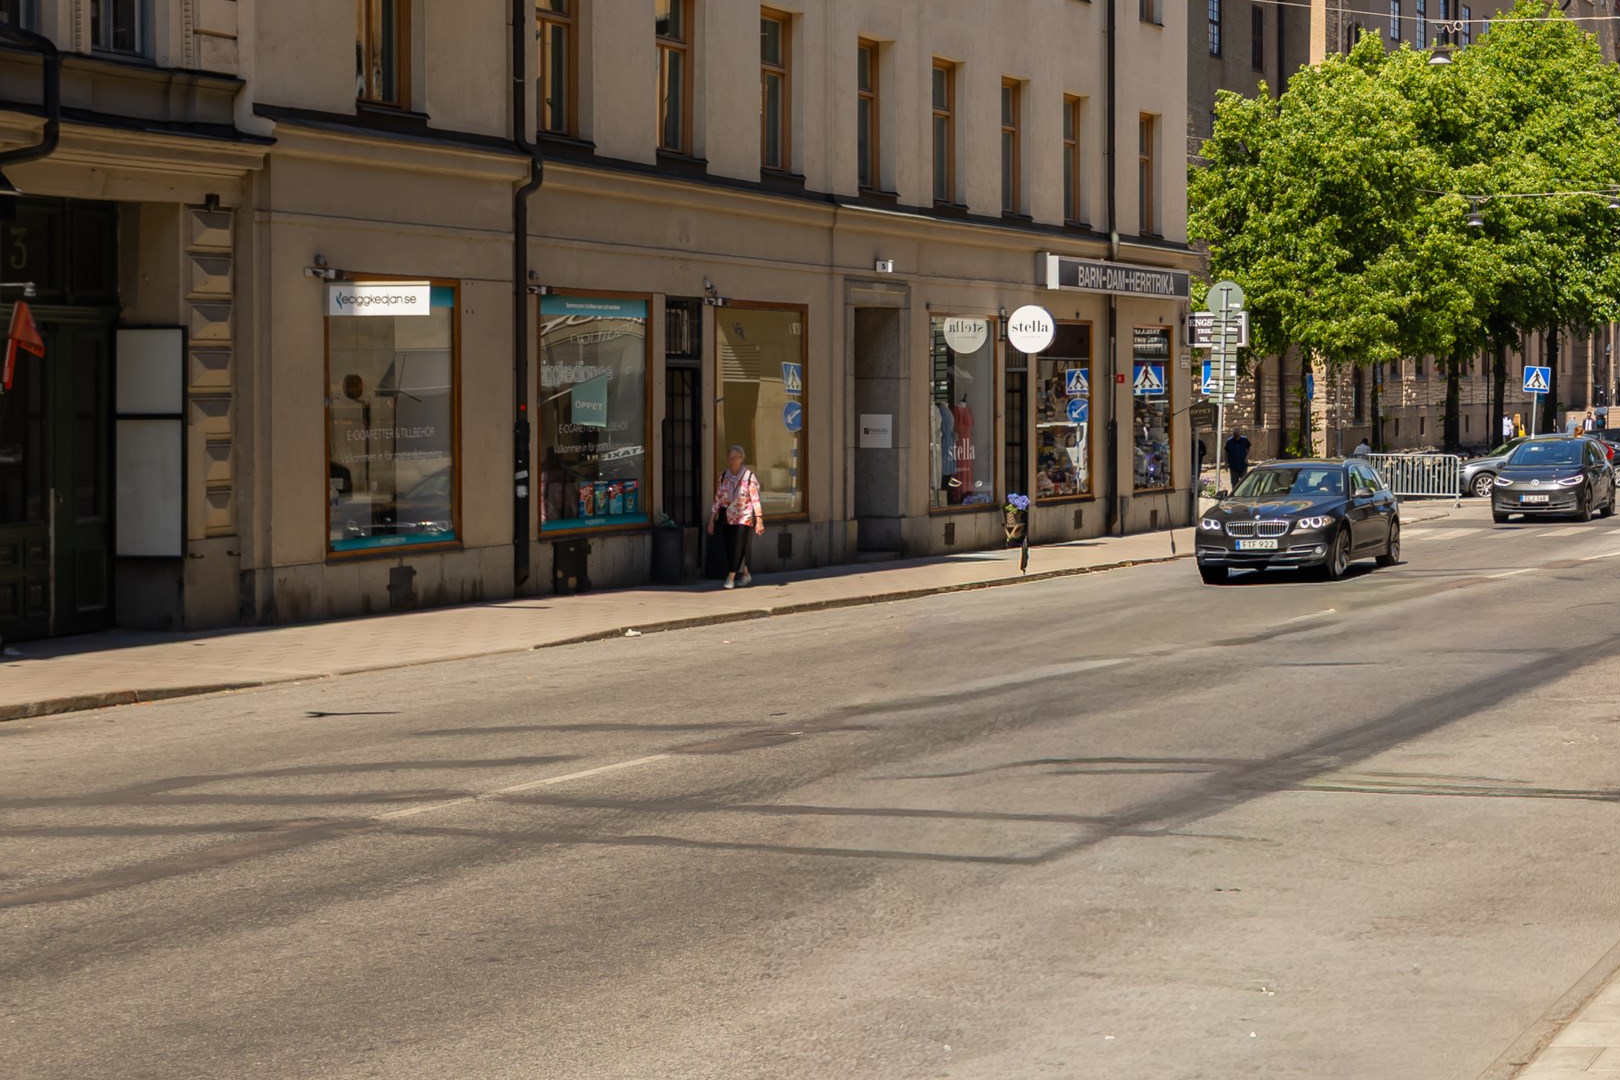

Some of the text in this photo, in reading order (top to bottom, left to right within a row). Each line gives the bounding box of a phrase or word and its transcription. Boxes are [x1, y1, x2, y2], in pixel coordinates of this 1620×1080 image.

[10, 226, 28, 269] 3
[1012, 321, 1048, 333] stella
[575, 400, 603, 410] ÖPPET
[948, 438, 975, 460] stella
